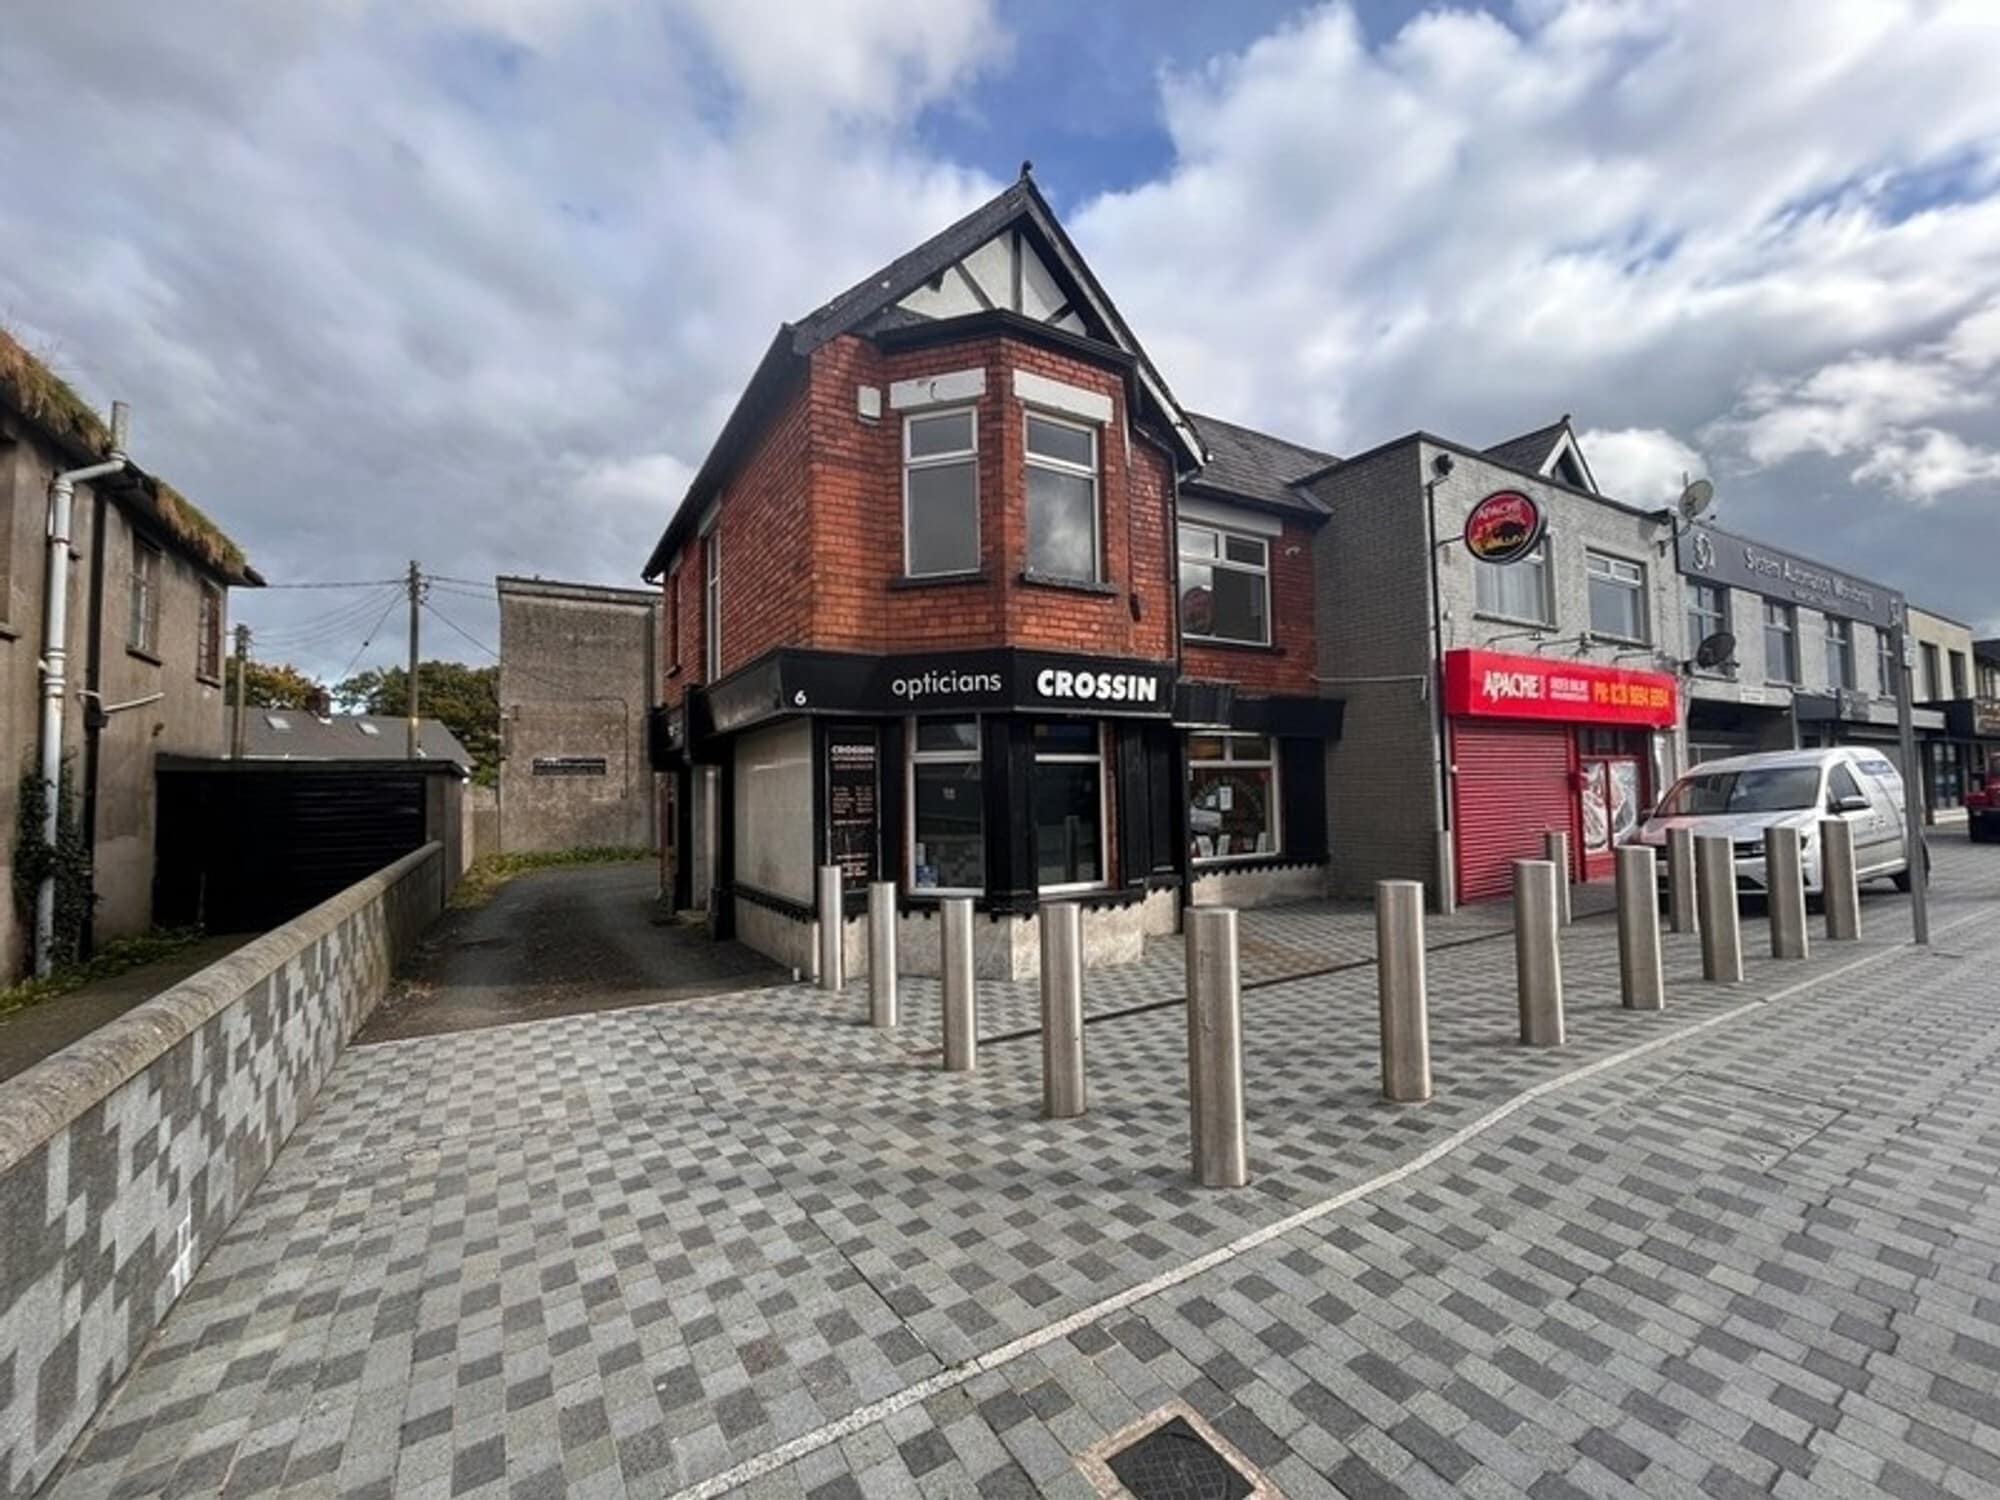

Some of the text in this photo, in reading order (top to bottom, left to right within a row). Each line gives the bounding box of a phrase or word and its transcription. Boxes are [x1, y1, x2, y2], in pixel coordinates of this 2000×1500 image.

[795, 690, 807, 706] 6
[891, 669, 1156, 701] opticians CROSSIN
[1483, 670, 1539, 703] APACHE
